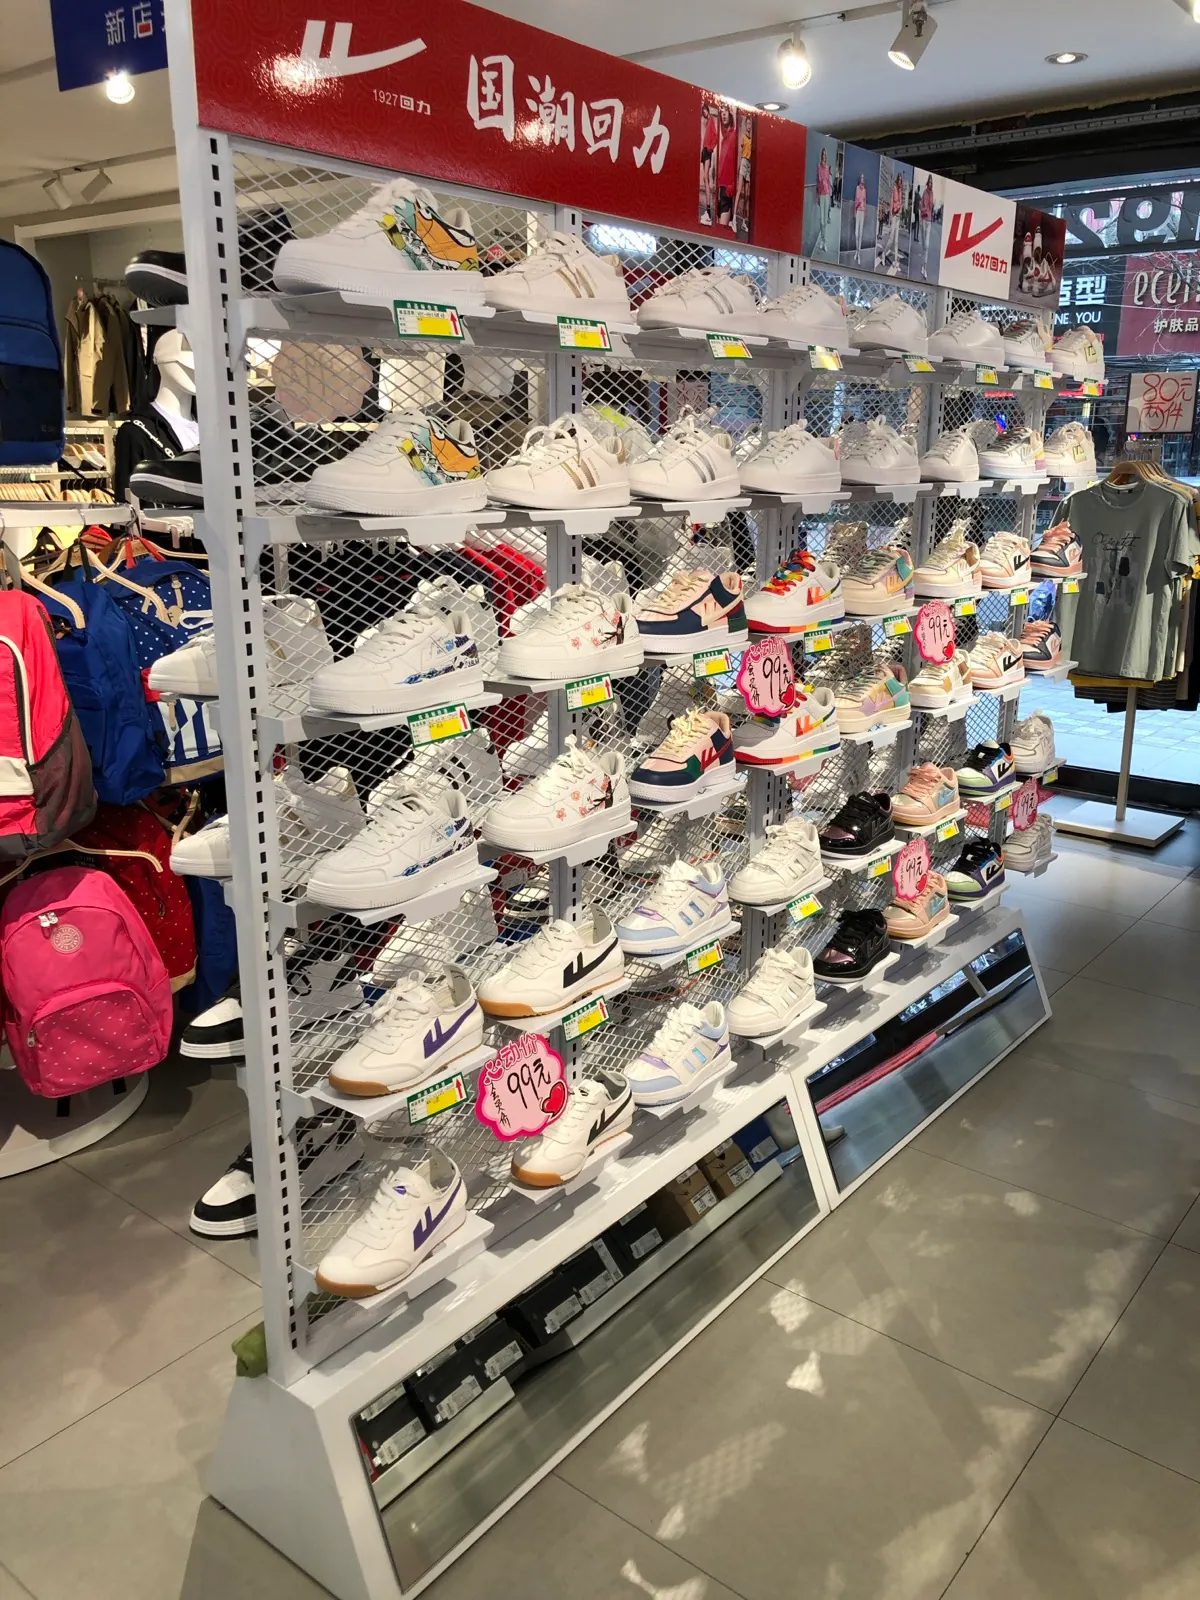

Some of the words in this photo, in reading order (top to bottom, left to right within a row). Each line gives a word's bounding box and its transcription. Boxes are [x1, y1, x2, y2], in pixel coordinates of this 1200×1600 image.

[104, 1, 164, 46] 新店
[372, 88, 431, 115] 1927回力
[467, 54, 670, 174] 国潮回力
[971, 251, 1008, 274] 1927回力
[1075, 310, 1102, 323] YOU
[1154, 317, 1199, 333] 护肤品
[1143, 373, 1193, 402] 80元
[1138, 401, 1184, 431] 两件
[928, 615, 951, 644] 99元
[762, 655, 792, 701] 99元
[483, 1032, 537, 1086] 心动价
[506, 1057, 552, 1110] 99元
